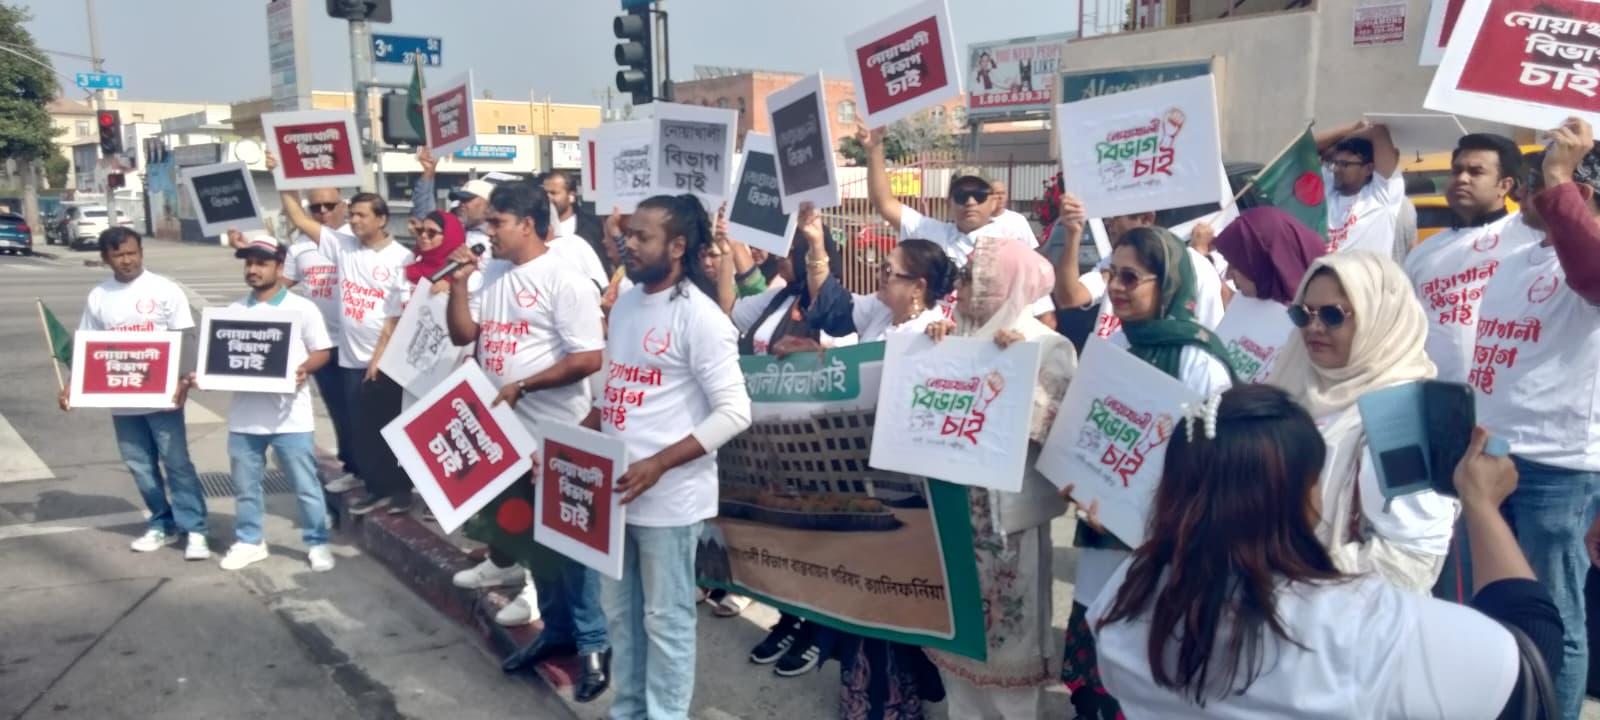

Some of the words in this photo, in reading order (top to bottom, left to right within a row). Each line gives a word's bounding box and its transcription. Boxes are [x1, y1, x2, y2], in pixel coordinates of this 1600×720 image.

[886, 69, 922, 96] চাই
[1519, 61, 1600, 97] চাই
[664, 144, 721, 172] বিভাগ
[1096, 135, 1159, 163] বিভাগ
[1133, 147, 1175, 178] চাই
[674, 168, 709, 193] চাই
[216, 328, 283, 342] নোয়াখালী
[228, 339, 272, 354] বিভাগ
[93, 347, 160, 361] নোয়াখালী
[106, 360, 150, 372] বিভাগ
[228, 353, 266, 371] চাই
[106, 372, 144, 388] চাই
[912, 384, 975, 415] বিভাগ
[452, 398, 503, 464] নোয়াখালী
[941, 409, 985, 445] চাই
[1086, 398, 1141, 450] বিভাগ
[429, 431, 463, 478] চাই
[445, 418, 481, 465] বিভাগ
[549, 457, 604, 488] নোয়াখালী
[1101, 443, 1144, 487] চাই
[559, 475, 594, 506] বিভাগ
[559, 500, 590, 533] চাই
